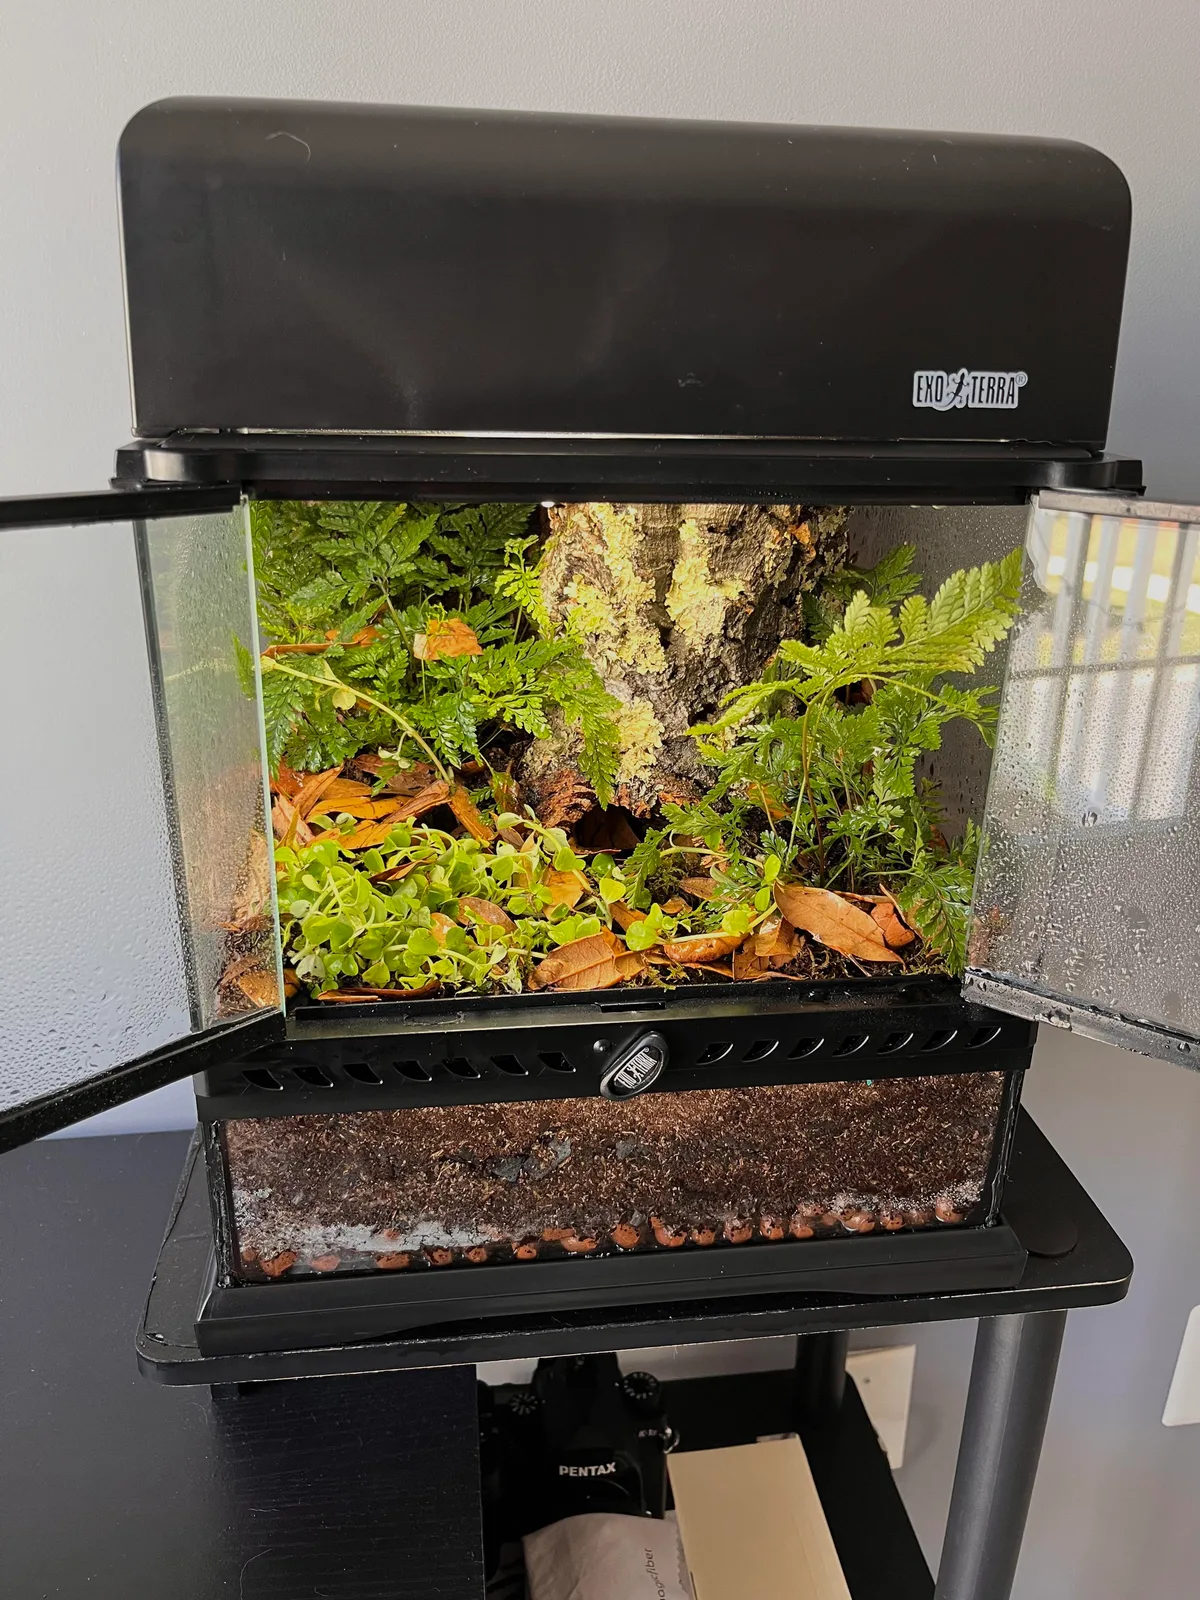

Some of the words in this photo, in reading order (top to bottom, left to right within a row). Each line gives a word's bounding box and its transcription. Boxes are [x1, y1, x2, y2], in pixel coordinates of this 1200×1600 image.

[917, 375, 944, 403] EXO
[559, 1461, 616, 1477] PENTAX
[645, 1548, 666, 1600] agicfiber
